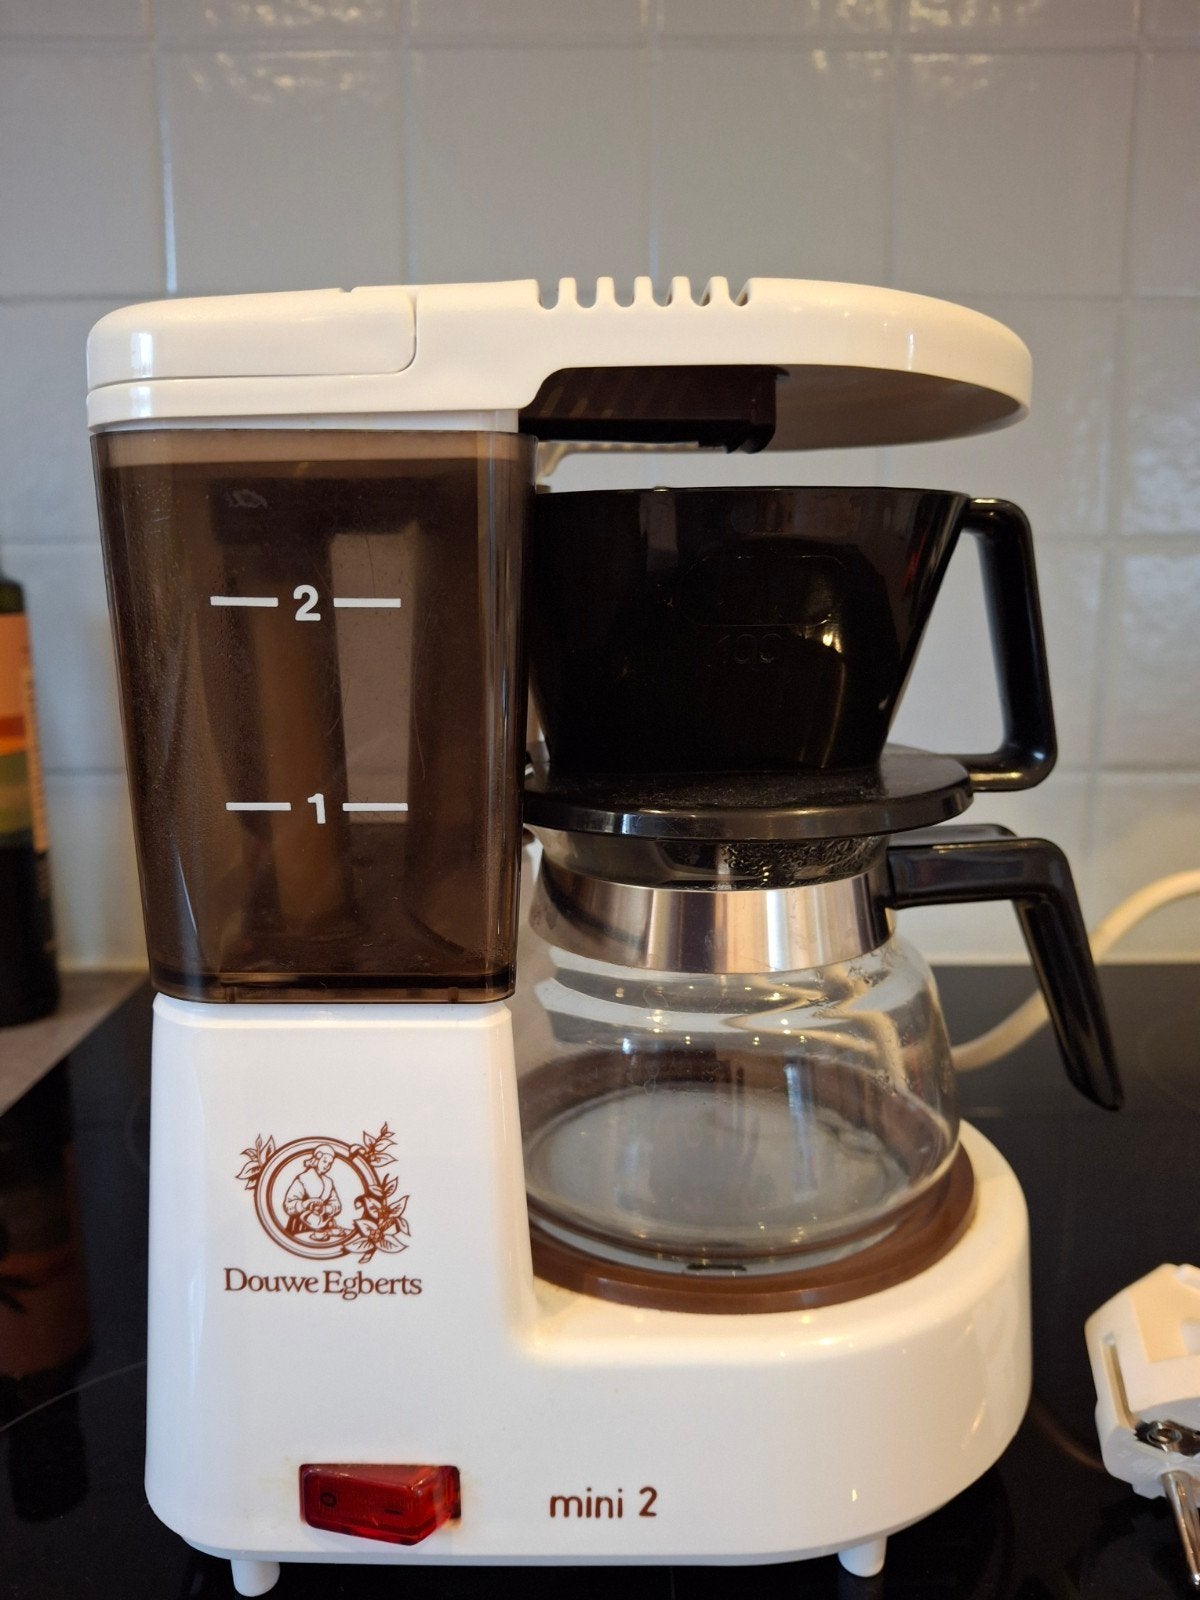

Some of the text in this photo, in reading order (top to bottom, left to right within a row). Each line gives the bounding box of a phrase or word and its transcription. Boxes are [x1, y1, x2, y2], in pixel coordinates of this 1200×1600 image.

[293, 584, 321, 621] 2
[307, 793, 326, 824] 1
[224, 1267, 422, 1300] Douwe Egberts
[549, 1486, 658, 1519] mini 2
